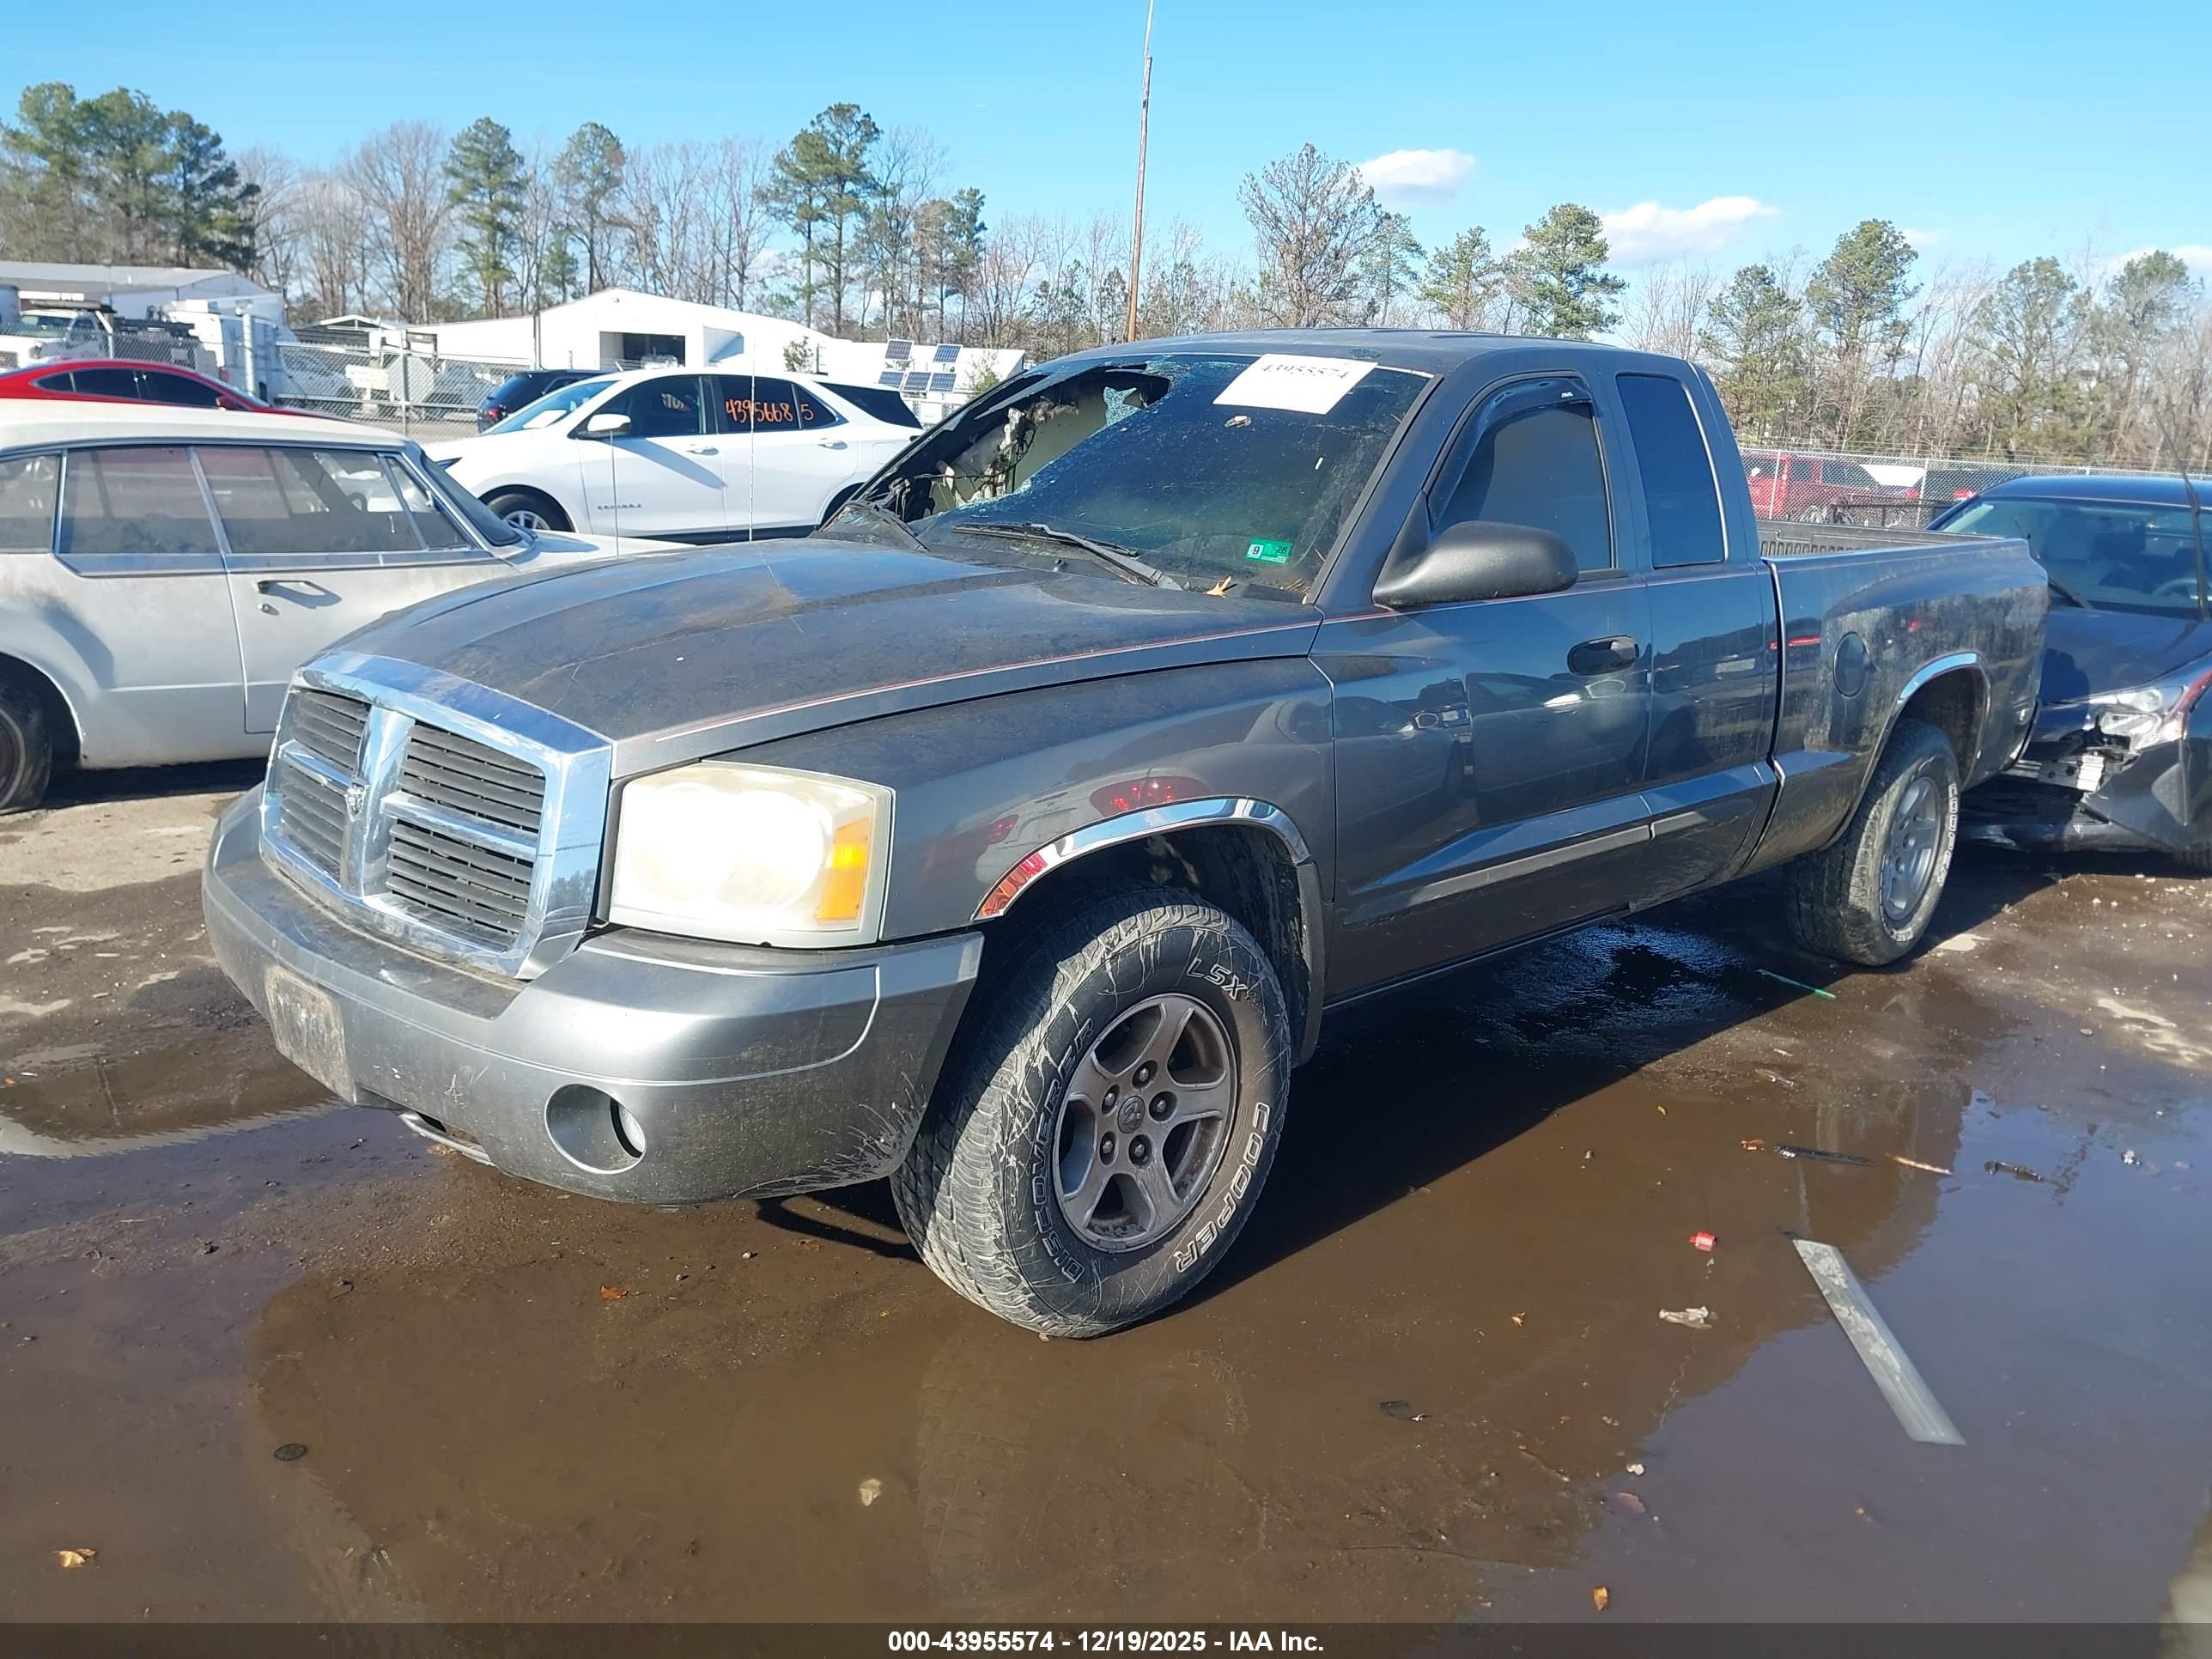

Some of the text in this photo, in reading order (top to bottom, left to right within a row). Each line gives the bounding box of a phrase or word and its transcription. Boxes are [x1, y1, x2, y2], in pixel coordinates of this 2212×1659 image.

[1187, 957, 1249, 1000] LSX
[1032, 1017, 1096, 1284] DISCOVERER
[1176, 1101, 1272, 1275] COOPER
